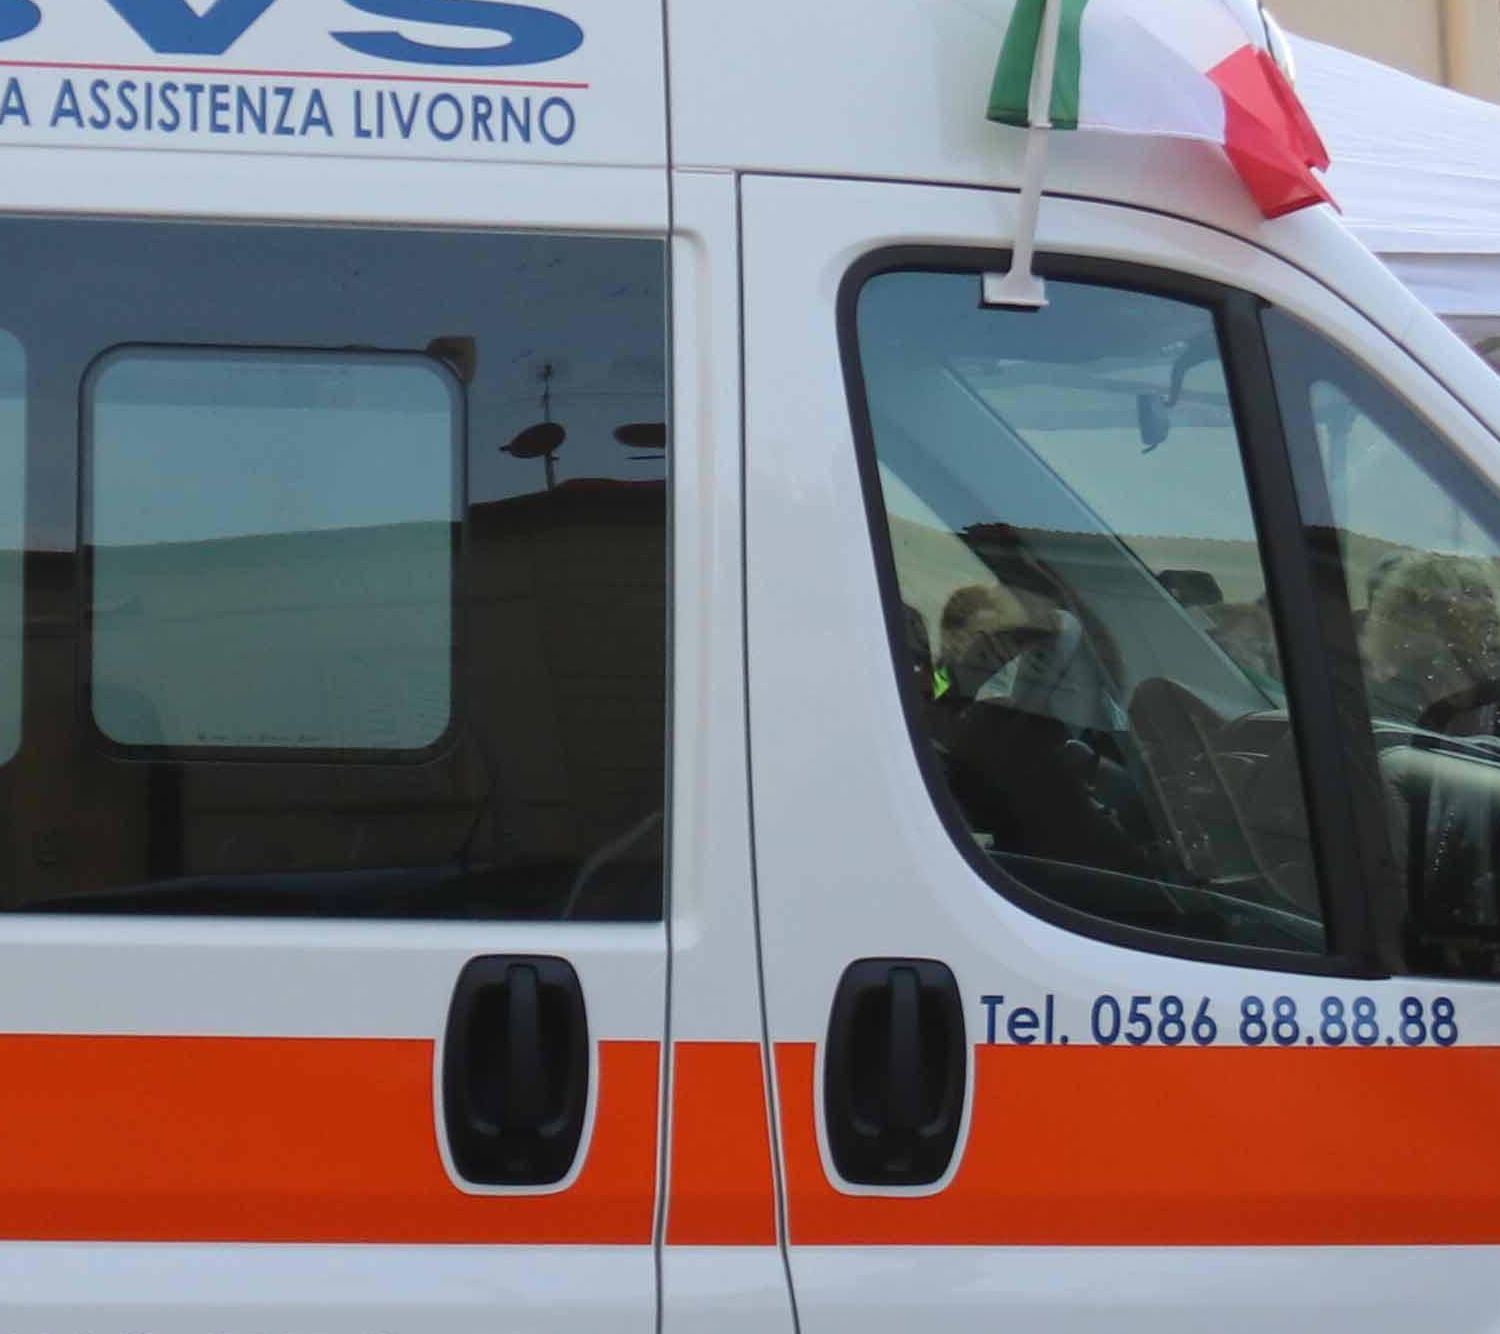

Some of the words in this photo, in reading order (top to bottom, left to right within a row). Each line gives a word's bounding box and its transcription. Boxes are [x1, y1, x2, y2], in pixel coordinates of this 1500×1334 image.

[49, 79, 335, 137] ASSISTENZA
[354, 88, 578, 147] LIVORNO
[980, 994, 1069, 1046] Tel.
[1090, 994, 1218, 1047] 0586
[1238, 995, 1459, 1047] 88.88.88
